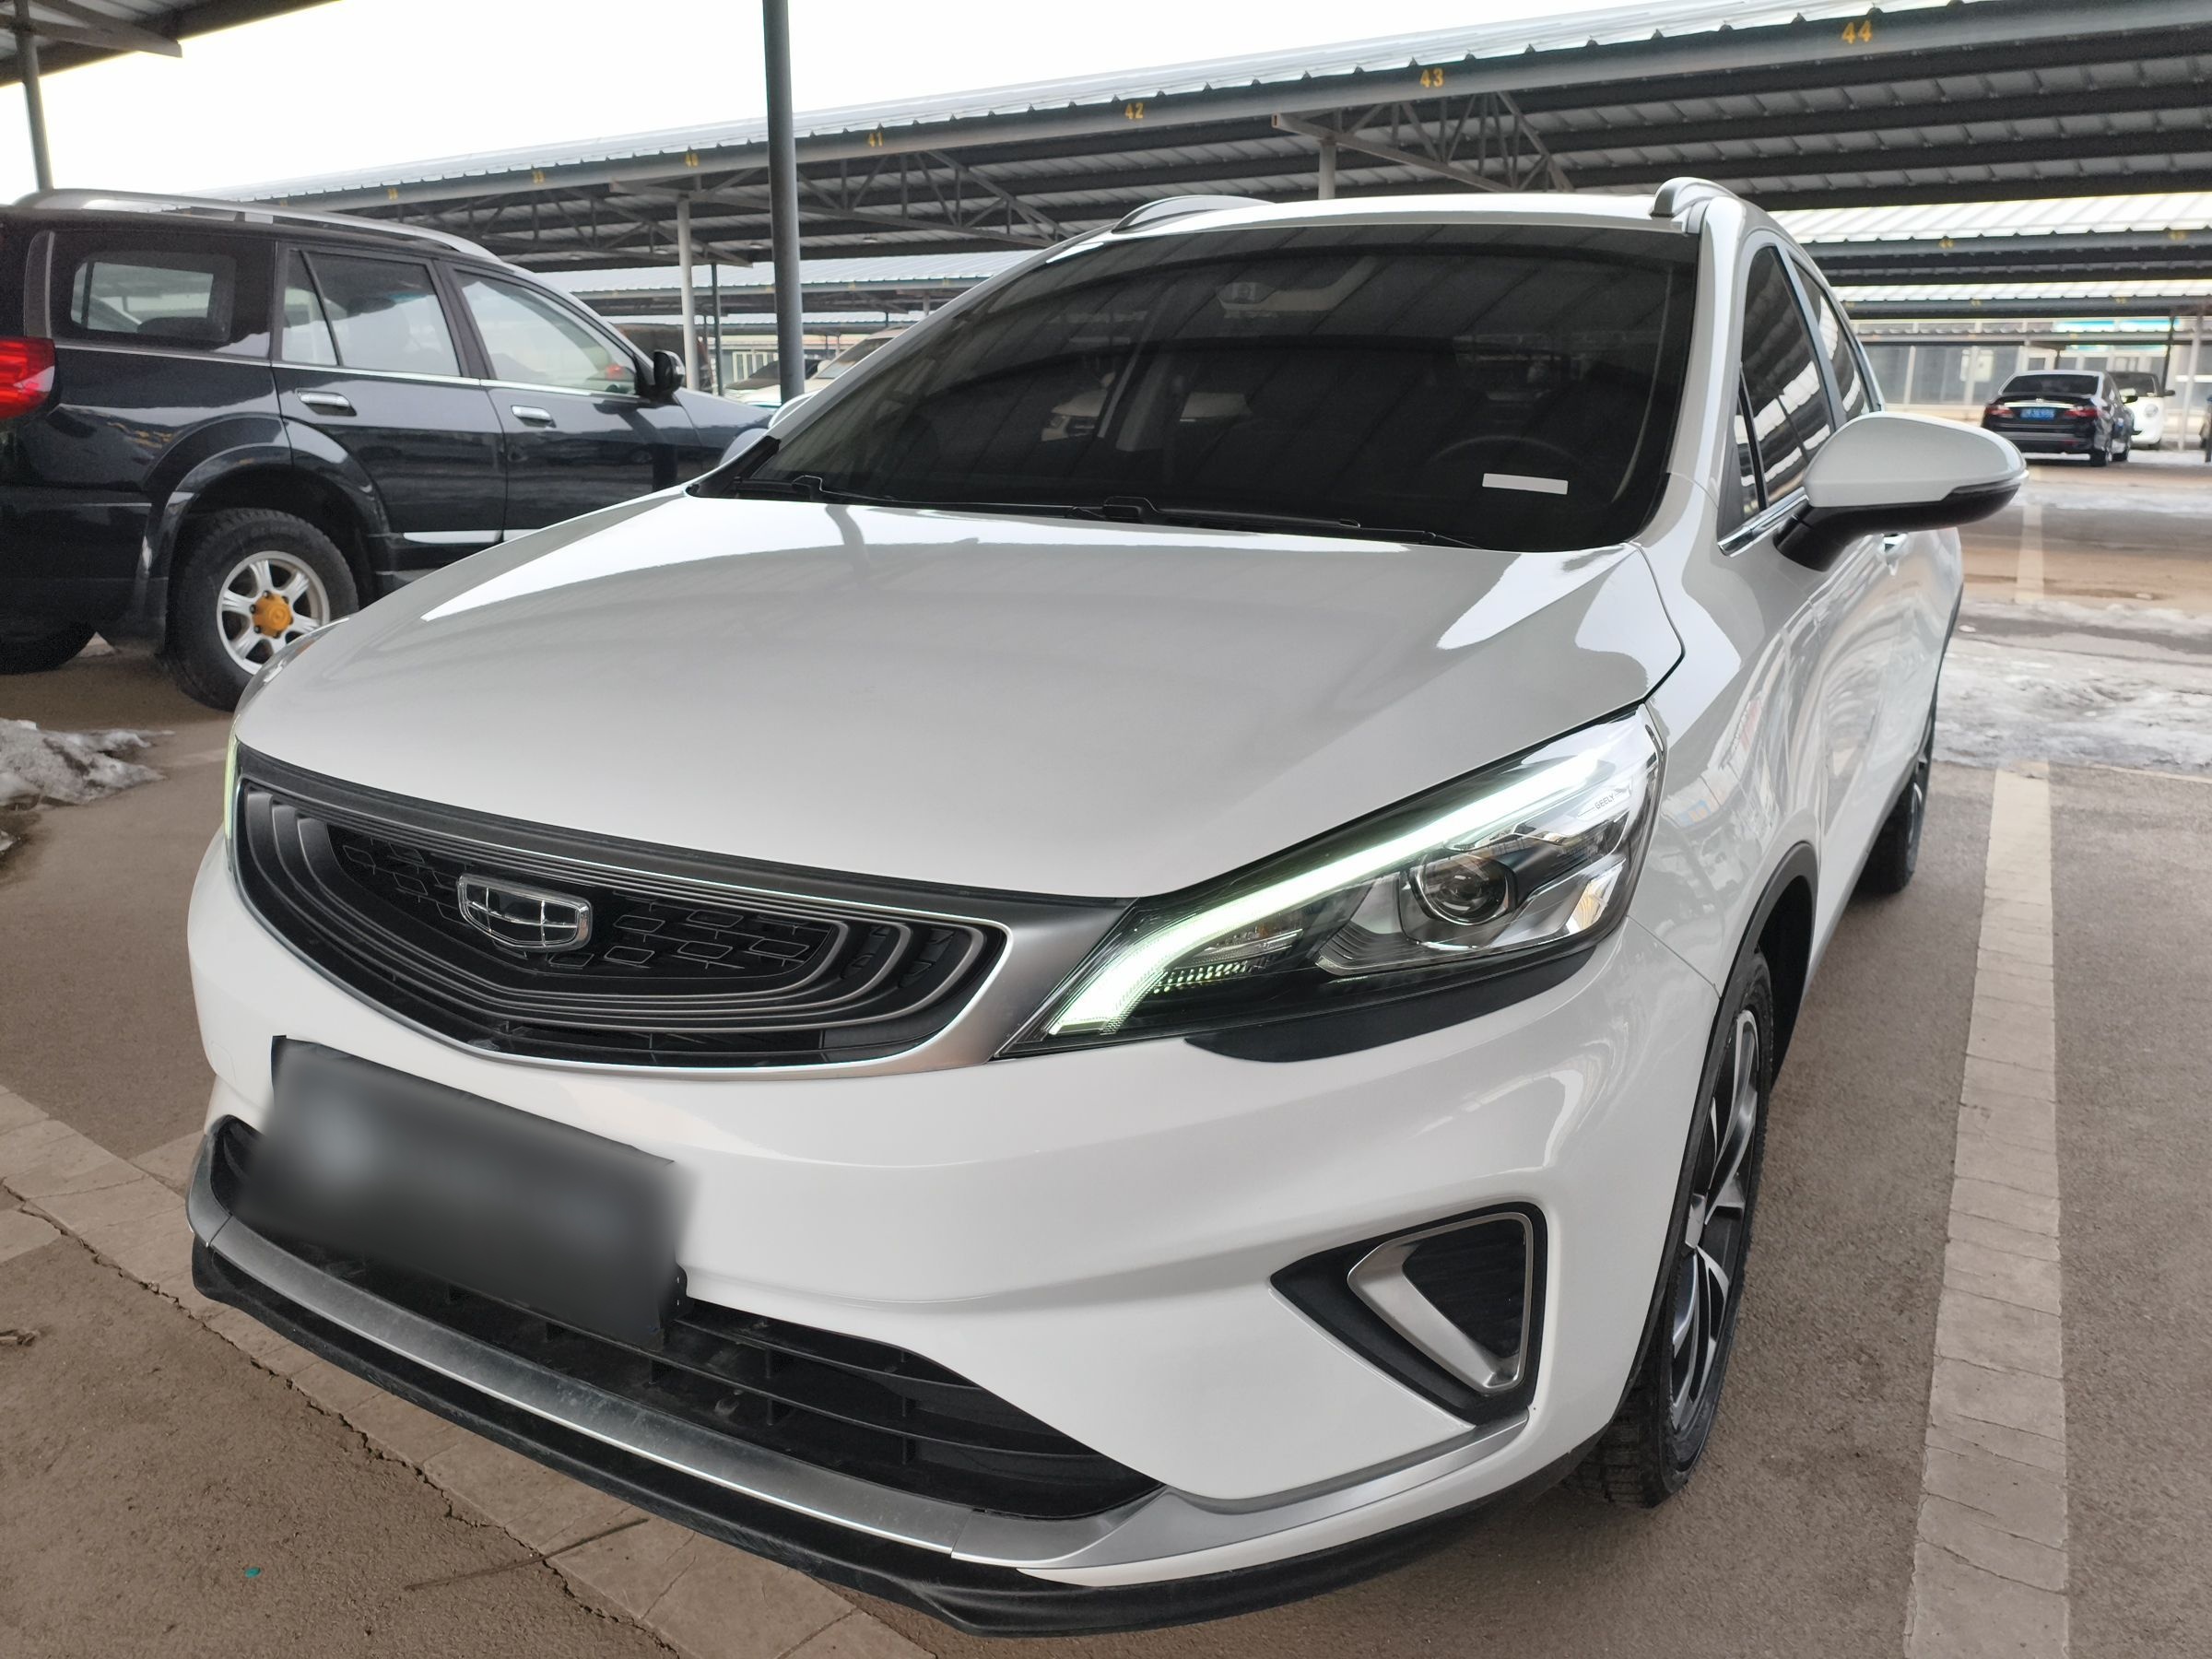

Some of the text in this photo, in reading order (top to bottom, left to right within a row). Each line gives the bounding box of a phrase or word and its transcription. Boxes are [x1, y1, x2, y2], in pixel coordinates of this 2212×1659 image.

[1841, 20, 1872, 44] 44
[1420, 67, 1443, 88] 43
[1124, 102, 1144, 120] 42
[1594, 793, 1615, 809] GEELY
